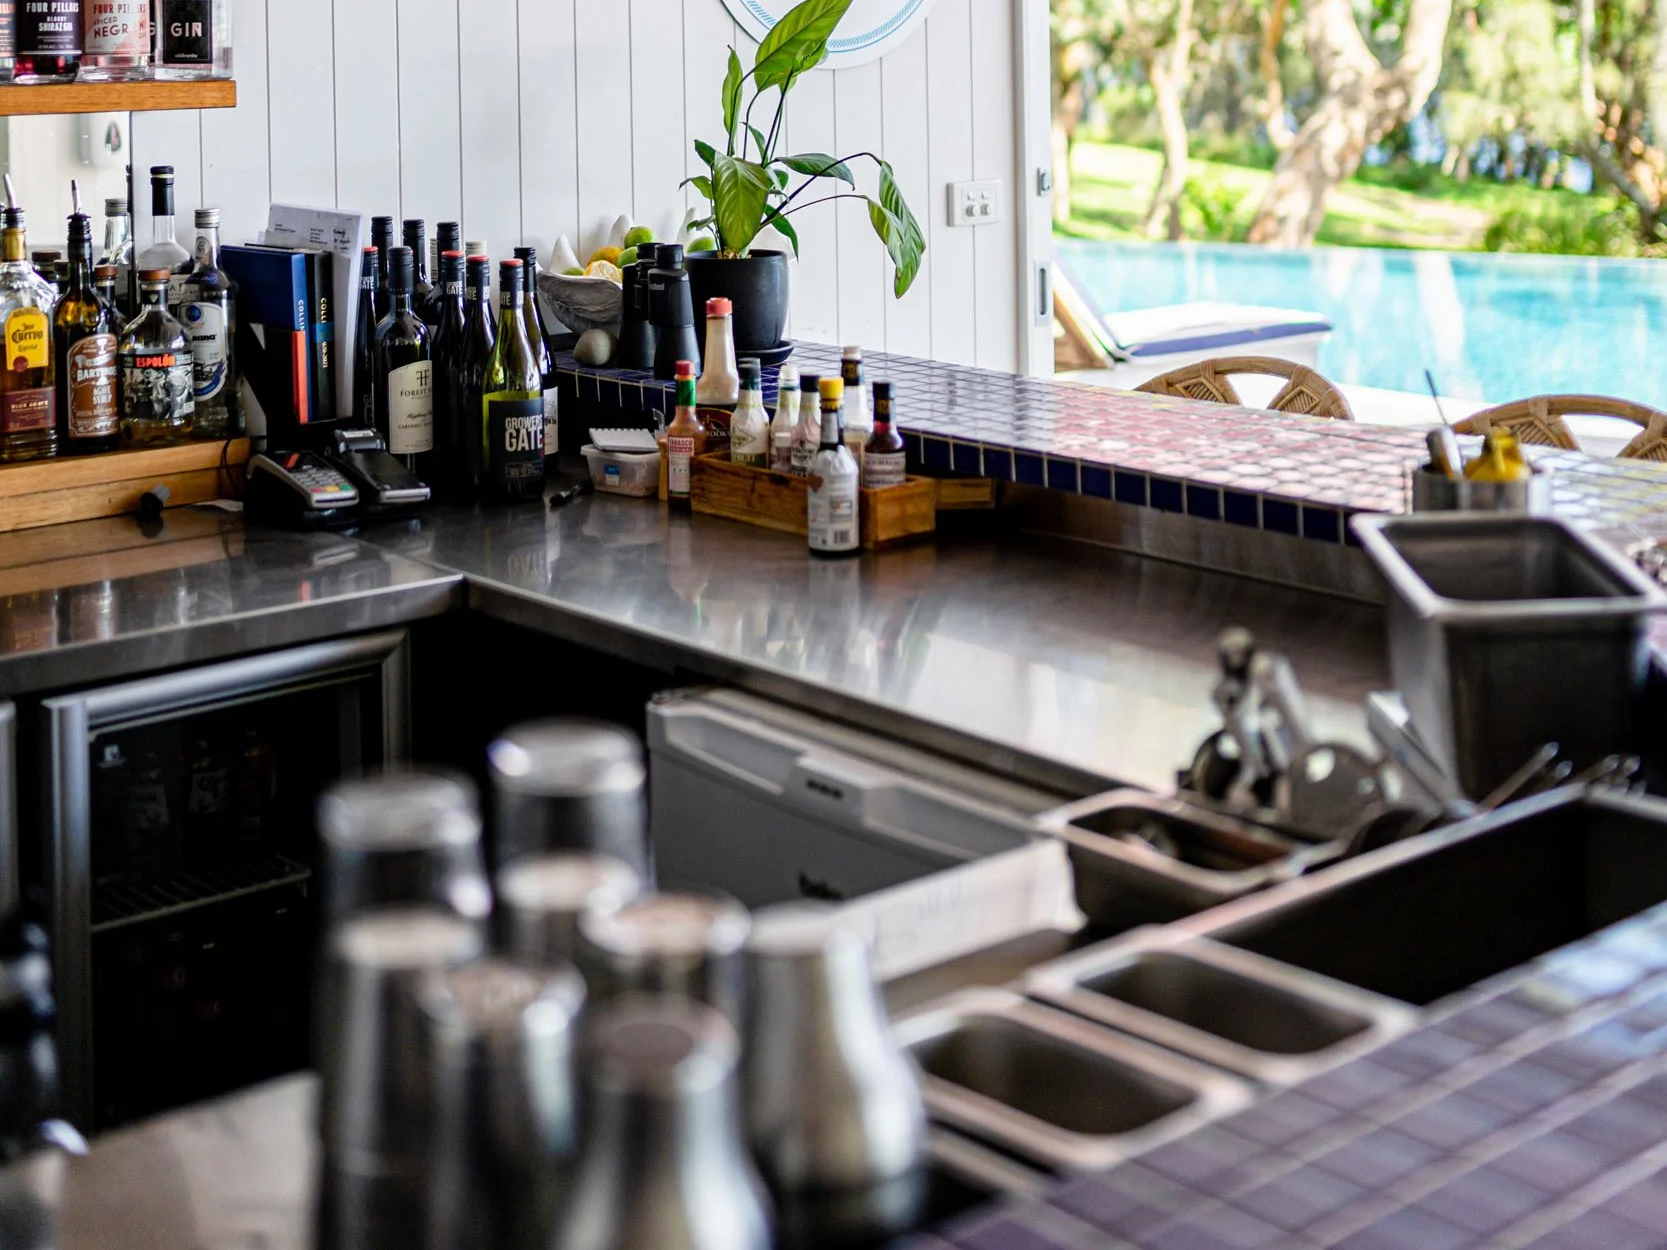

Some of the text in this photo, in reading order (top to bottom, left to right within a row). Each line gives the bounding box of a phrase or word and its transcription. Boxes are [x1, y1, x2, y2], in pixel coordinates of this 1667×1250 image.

[26, 2, 49, 13] FOUR
[93, 3, 114, 14] FOUR
[171, 22, 203, 37] GIN
[11, 328, 43, 344] Cuervo
[505, 414, 543, 430] GROWERS
[505, 427, 543, 453] GATE
